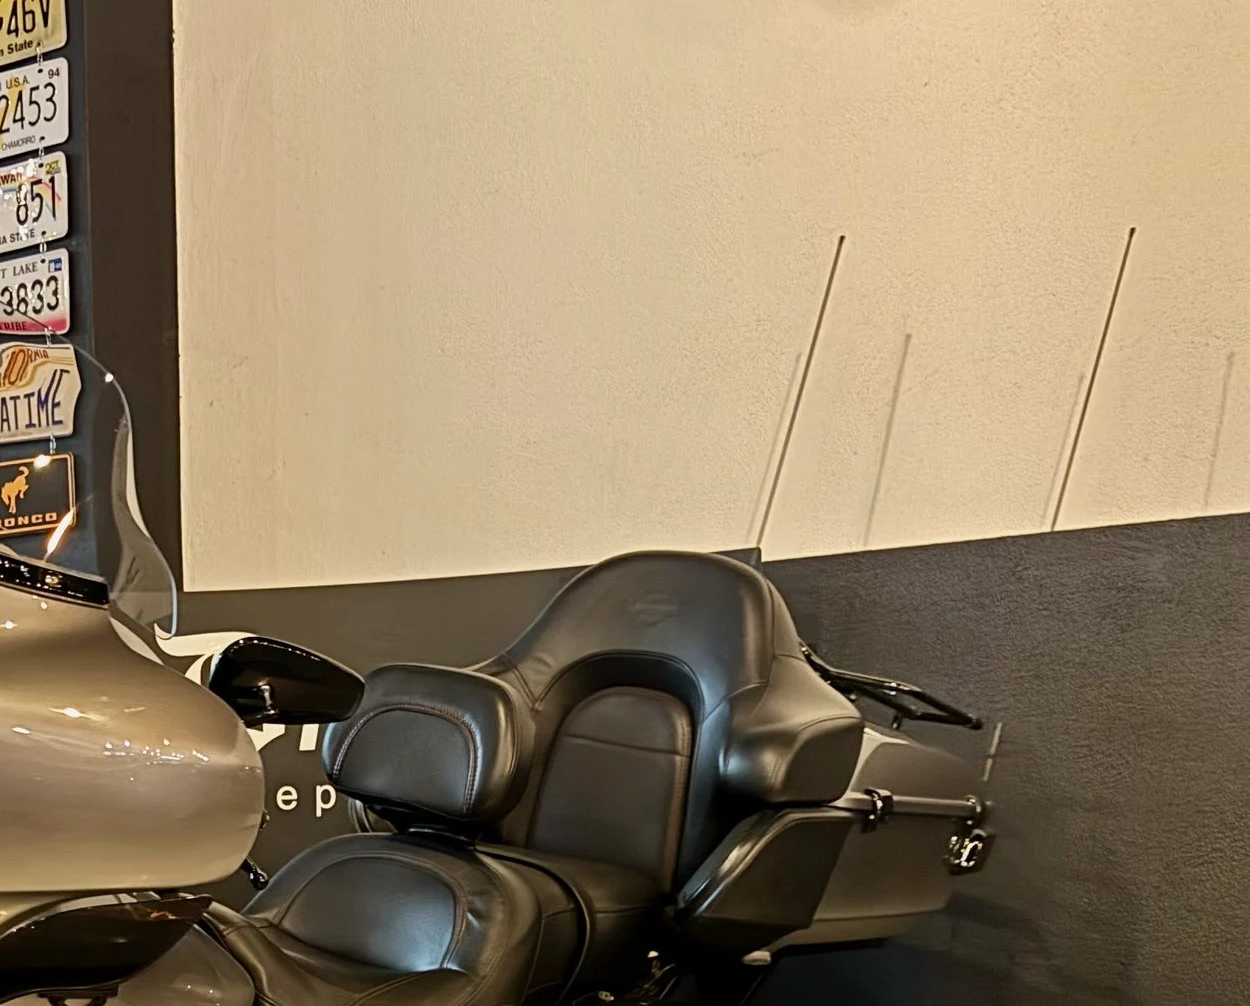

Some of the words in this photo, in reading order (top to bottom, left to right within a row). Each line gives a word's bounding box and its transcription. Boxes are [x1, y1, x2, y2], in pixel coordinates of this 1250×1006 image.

[7, 40, 34, 55] State
[48, 67, 61, 79] 94
[15, 175, 57, 226] 851
[9, 228, 36, 243] STTE
[13, 261, 38, 277] LAKE
[0, 275, 60, 316] 3833
